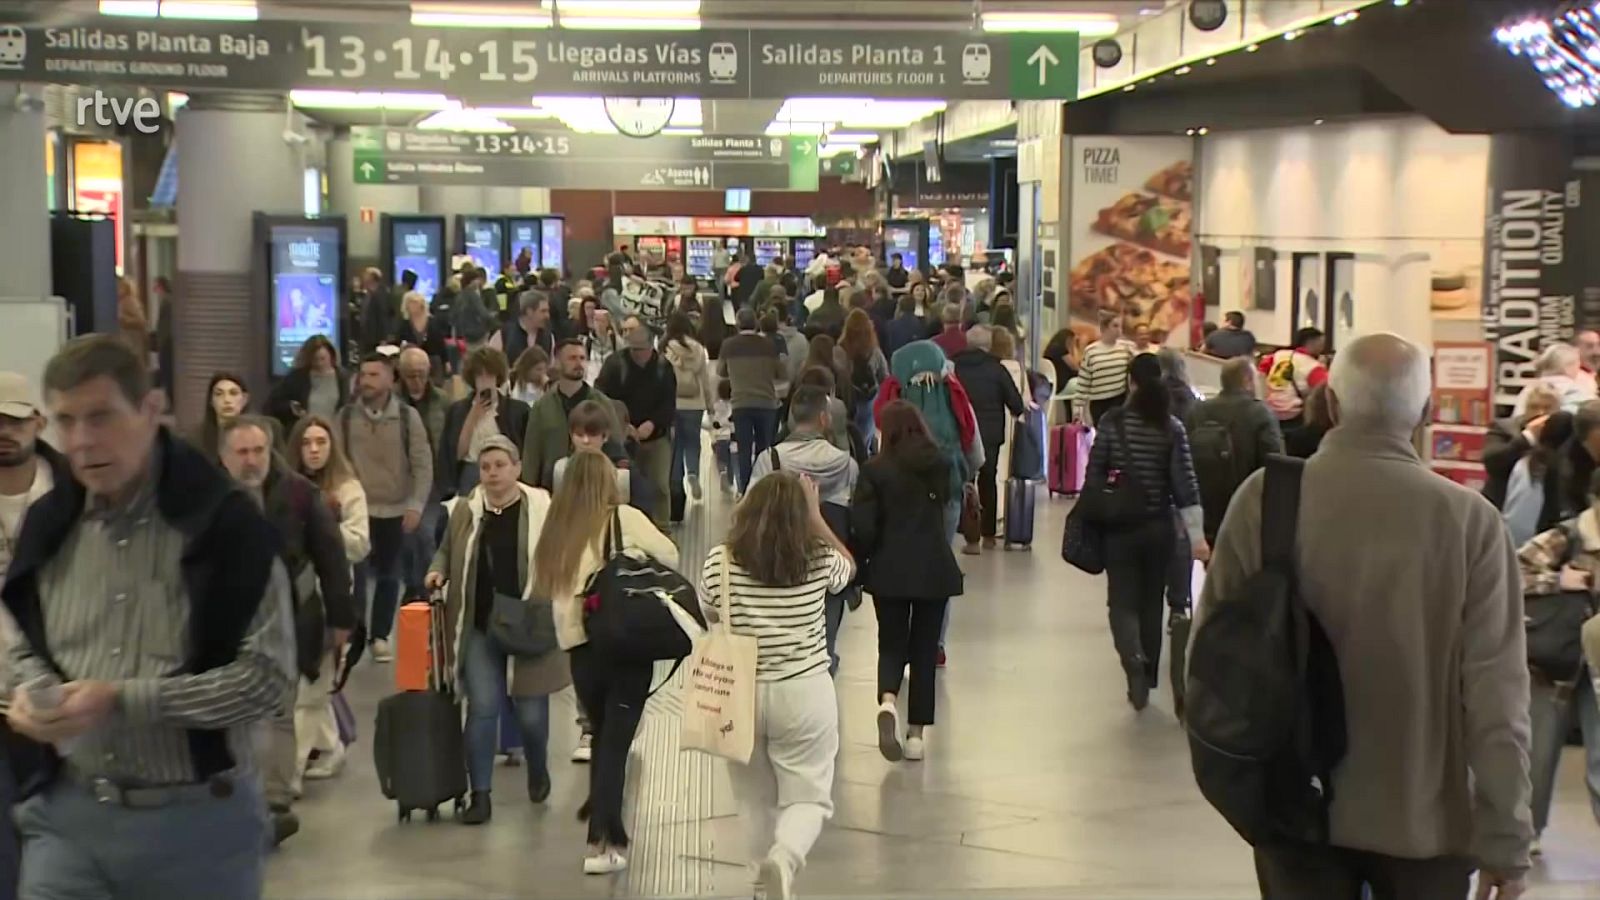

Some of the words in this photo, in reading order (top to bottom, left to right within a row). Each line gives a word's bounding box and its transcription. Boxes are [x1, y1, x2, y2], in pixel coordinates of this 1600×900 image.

[45, 28, 129, 50] Salidas
[136, 31, 211, 54] Planta
[219, 34, 270, 60] Baja
[547, 42, 648, 68] Llegadas
[655, 42, 702, 65] Vías
[761, 43, 844, 65] Salidas
[851, 44, 924, 65] Planta
[933, 45, 946, 65] 1
[45, 58, 127, 74] DEPARTURES
[129, 62, 185, 76] GROUND
[187, 64, 228, 77] FLOOR
[572, 70, 630, 83] ARRIVALS
[633, 71, 701, 84] PLATFORMS
[819, 72, 893, 84] DEPARTURES
[896, 72, 934, 84] FLOOR
[939, 73, 946, 84] 1
[691, 138, 723, 148] Salidas
[725, 138, 754, 148] Planta
[756, 138, 762, 148] 1
[1083, 147, 1121, 165] PIZZA
[1083, 166, 1118, 184] TIME!
[1540, 190, 1564, 265] QUALITY
